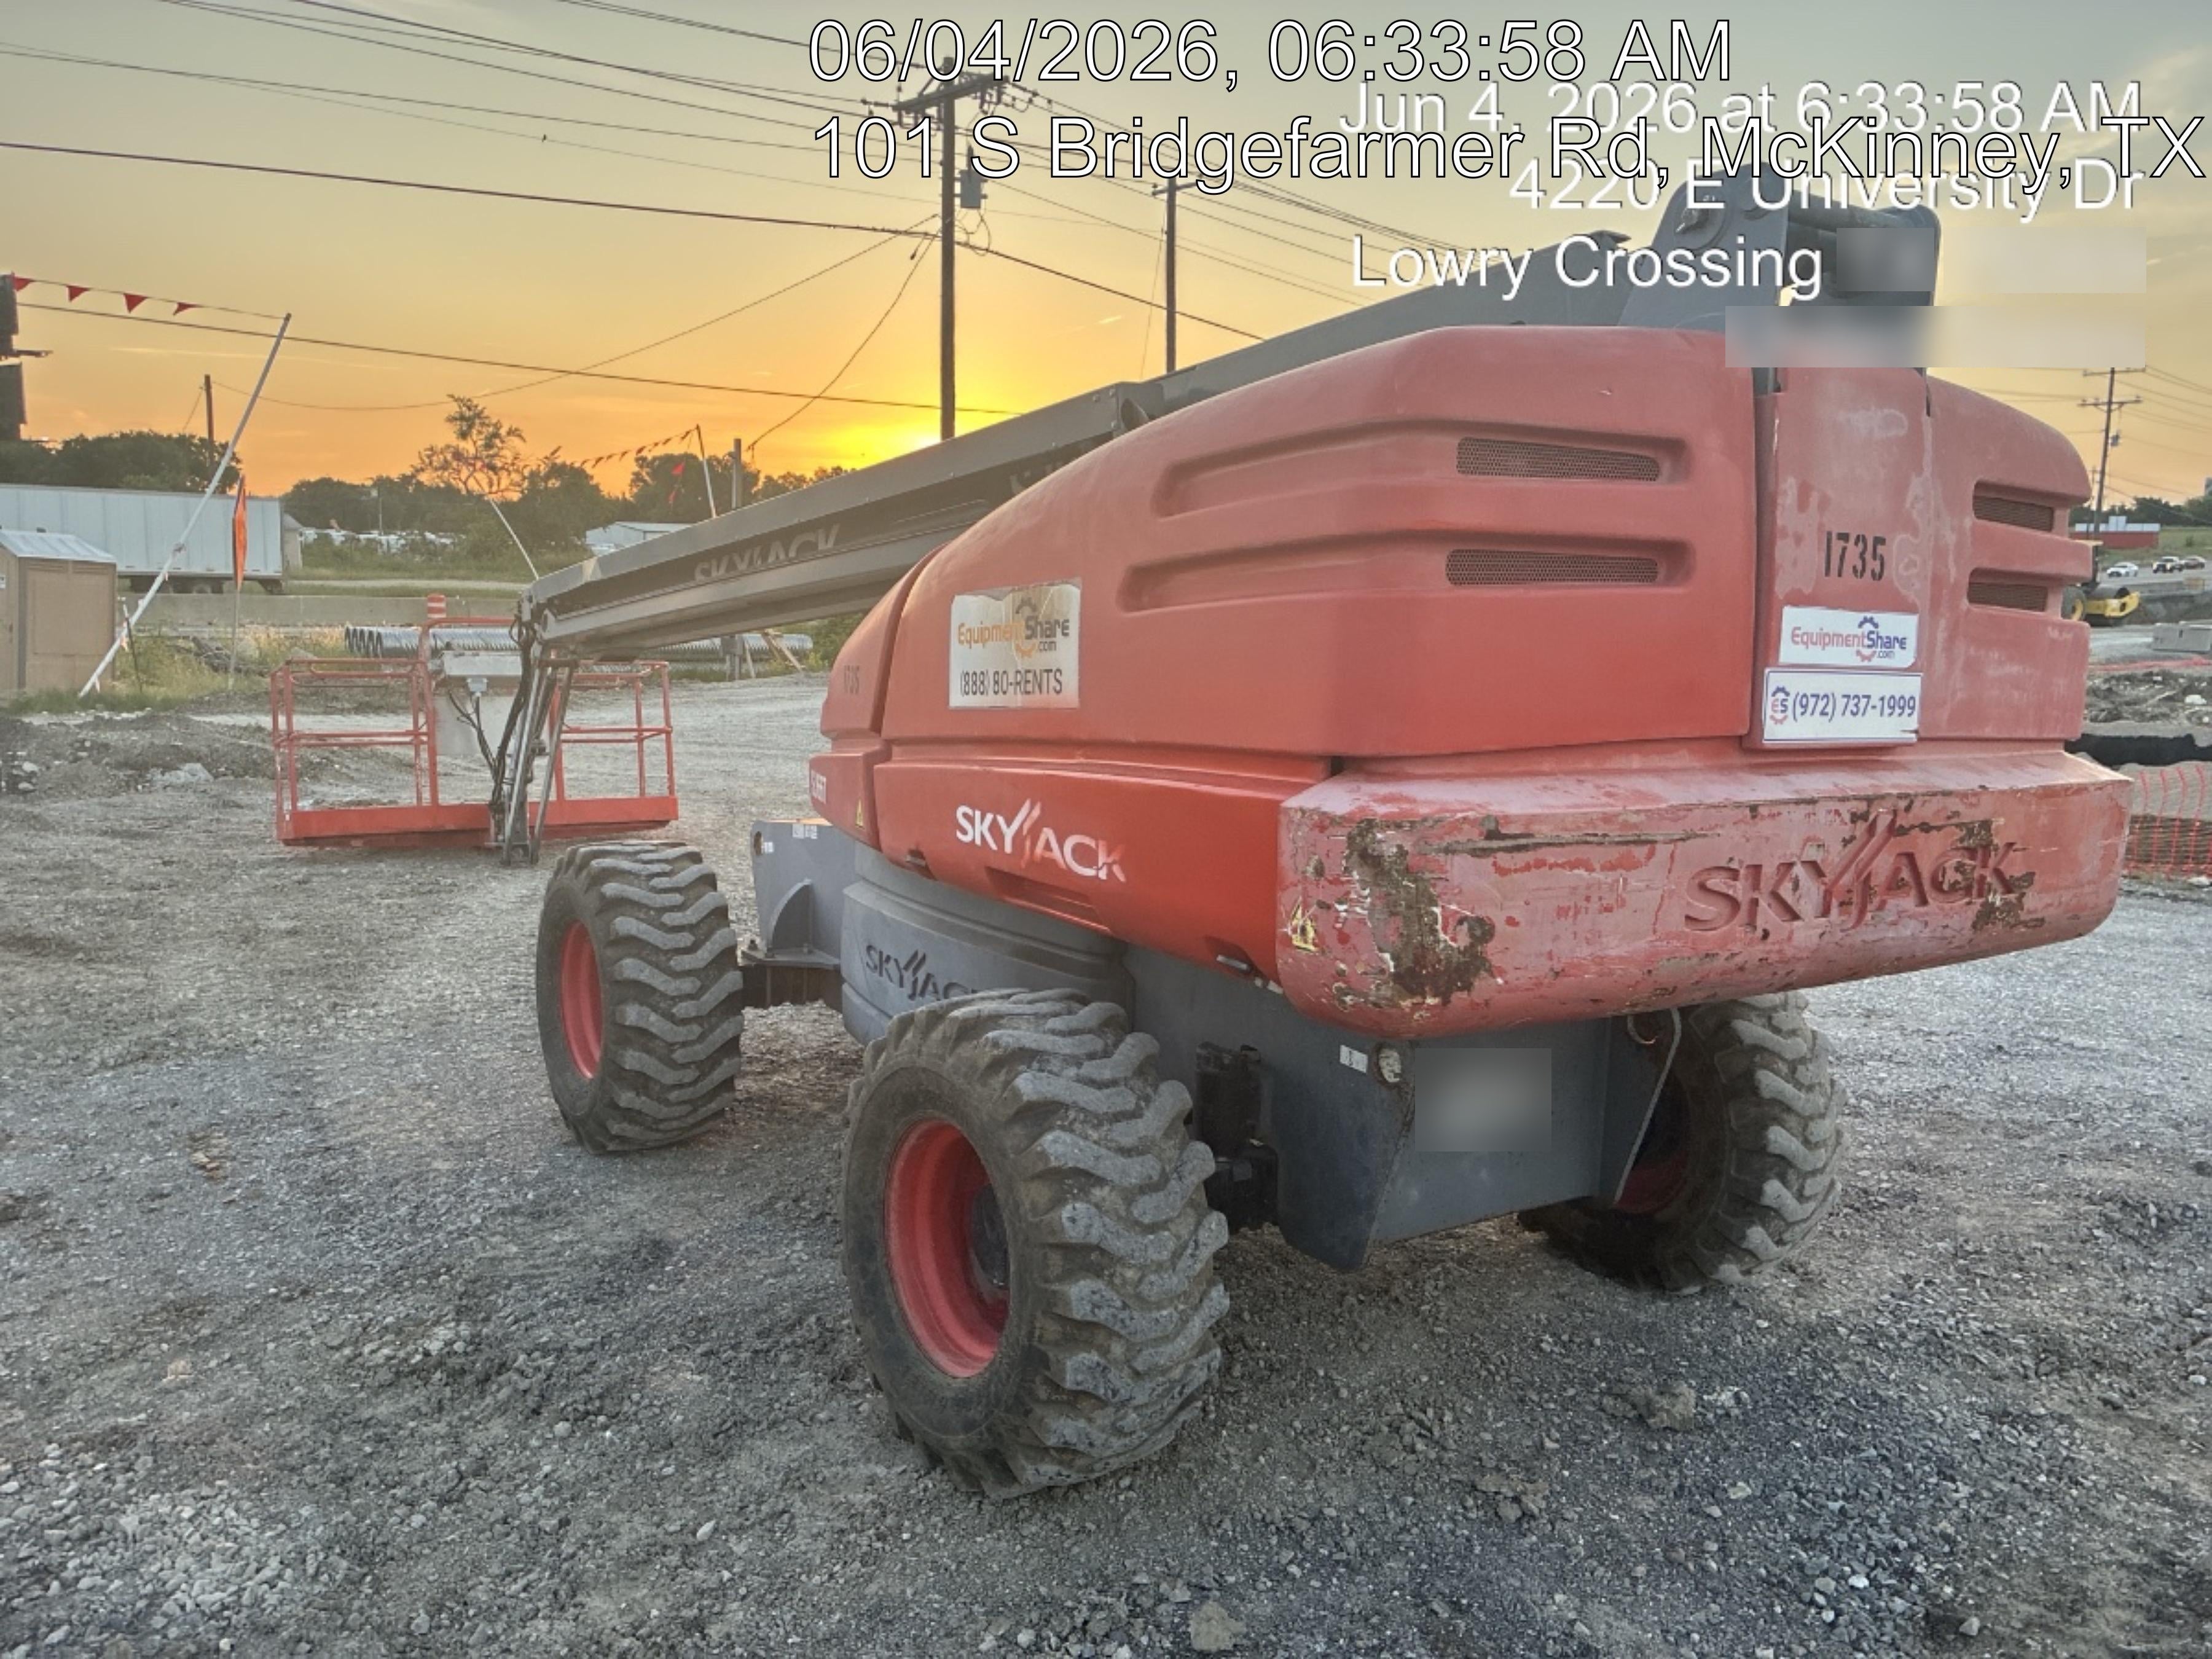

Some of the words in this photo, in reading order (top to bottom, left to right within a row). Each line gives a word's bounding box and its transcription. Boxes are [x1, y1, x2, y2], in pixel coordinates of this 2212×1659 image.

[1824, 530, 1887, 581] 1735
[1790, 626, 1907, 650] EquipmentShare
[960, 667, 990, 697] (888)
[993, 667, 1062, 696] 80-RENTS
[1793, 691, 1836, 723] (972)
[1841, 693, 1916, 718] 737-1999
[1684, 809, 2017, 932] SKYJACK
